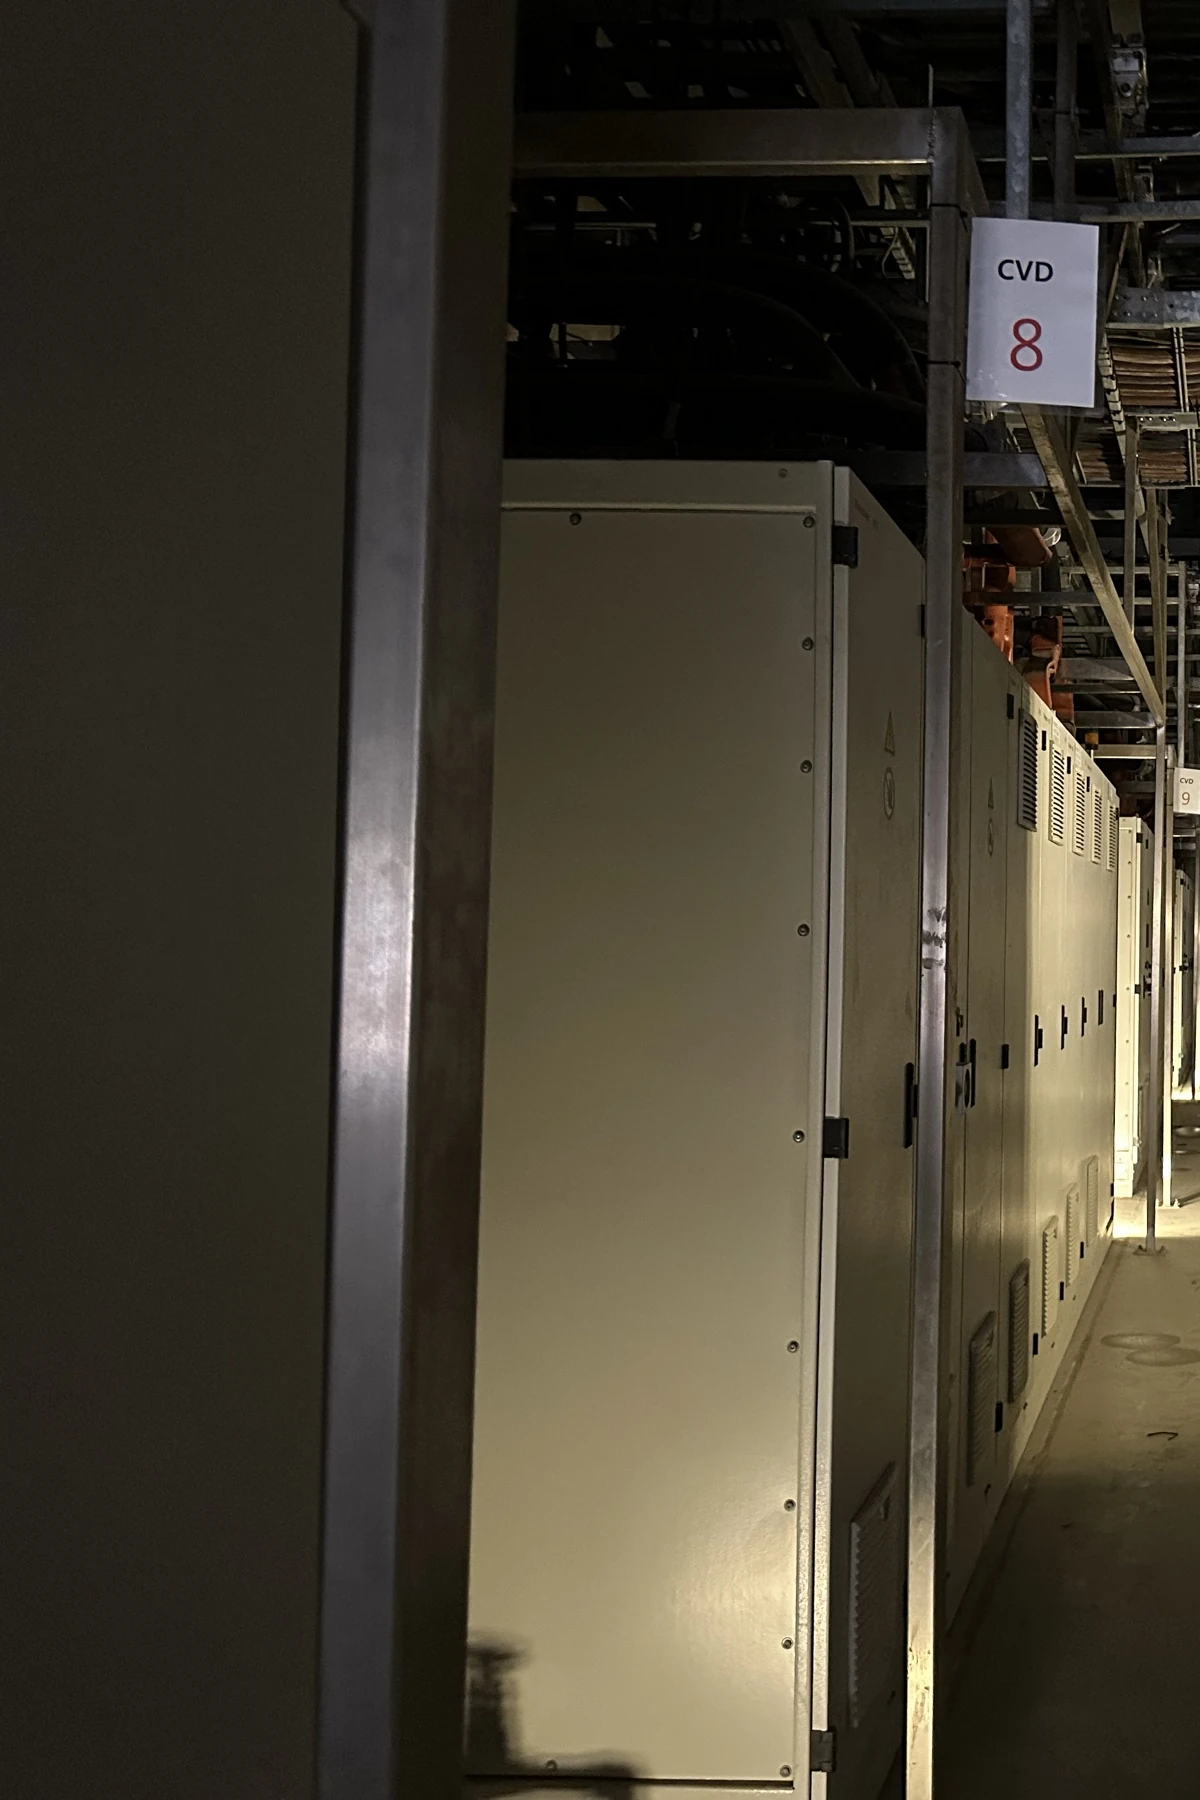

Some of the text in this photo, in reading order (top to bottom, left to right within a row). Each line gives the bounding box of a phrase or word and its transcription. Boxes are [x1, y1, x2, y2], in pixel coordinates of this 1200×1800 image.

[997, 259, 1054, 282] CVD
[1010, 318, 1043, 372] 8
[1182, 792, 1190, 805] 9
